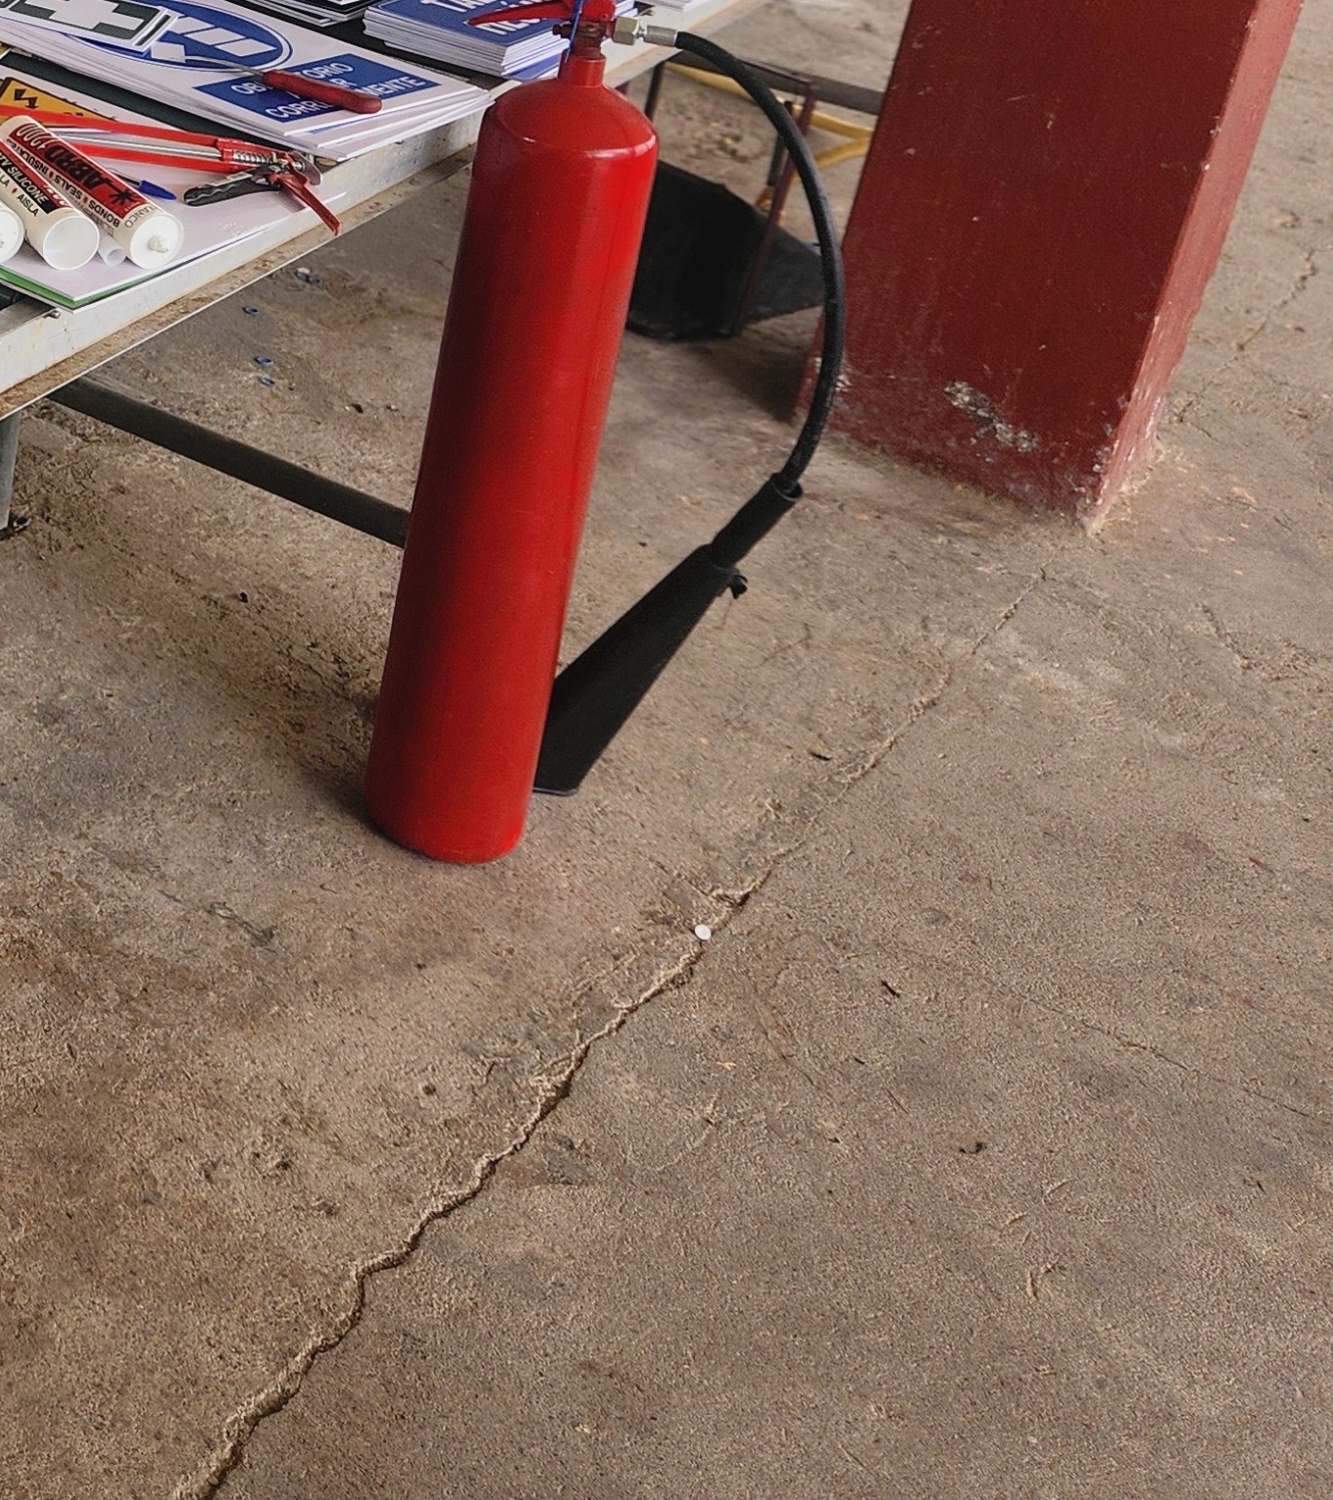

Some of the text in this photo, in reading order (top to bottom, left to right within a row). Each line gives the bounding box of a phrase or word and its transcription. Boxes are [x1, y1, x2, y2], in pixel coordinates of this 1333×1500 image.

[7, 166, 48, 205] SILICONE
[54, 175, 83, 200] SEALS
[17, 194, 40, 217] AISLA
[88, 201, 121, 228] BONDS
